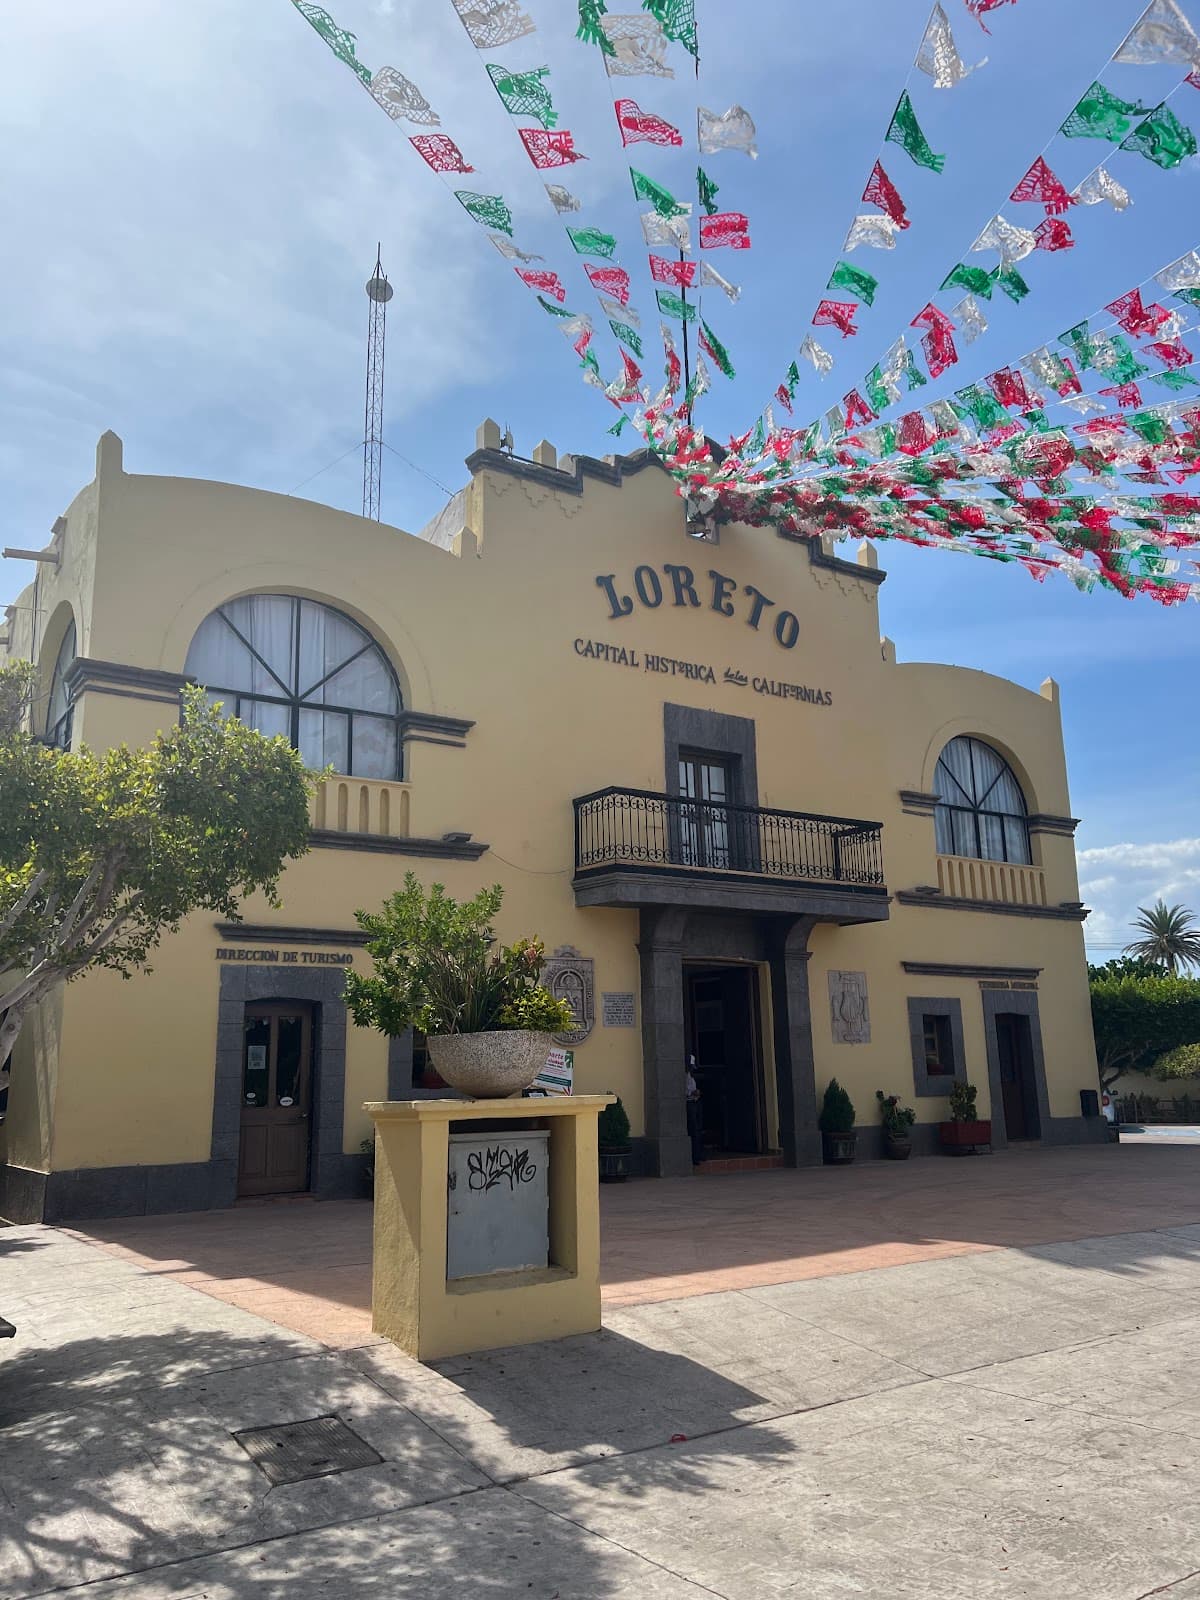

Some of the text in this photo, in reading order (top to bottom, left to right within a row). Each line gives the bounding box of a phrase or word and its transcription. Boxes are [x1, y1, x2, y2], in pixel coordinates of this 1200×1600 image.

[595, 563, 800, 649] LORETO
[574, 639, 639, 667] CAPITAL
[216, 948, 353, 964] DIRECCION DE TURISMO
